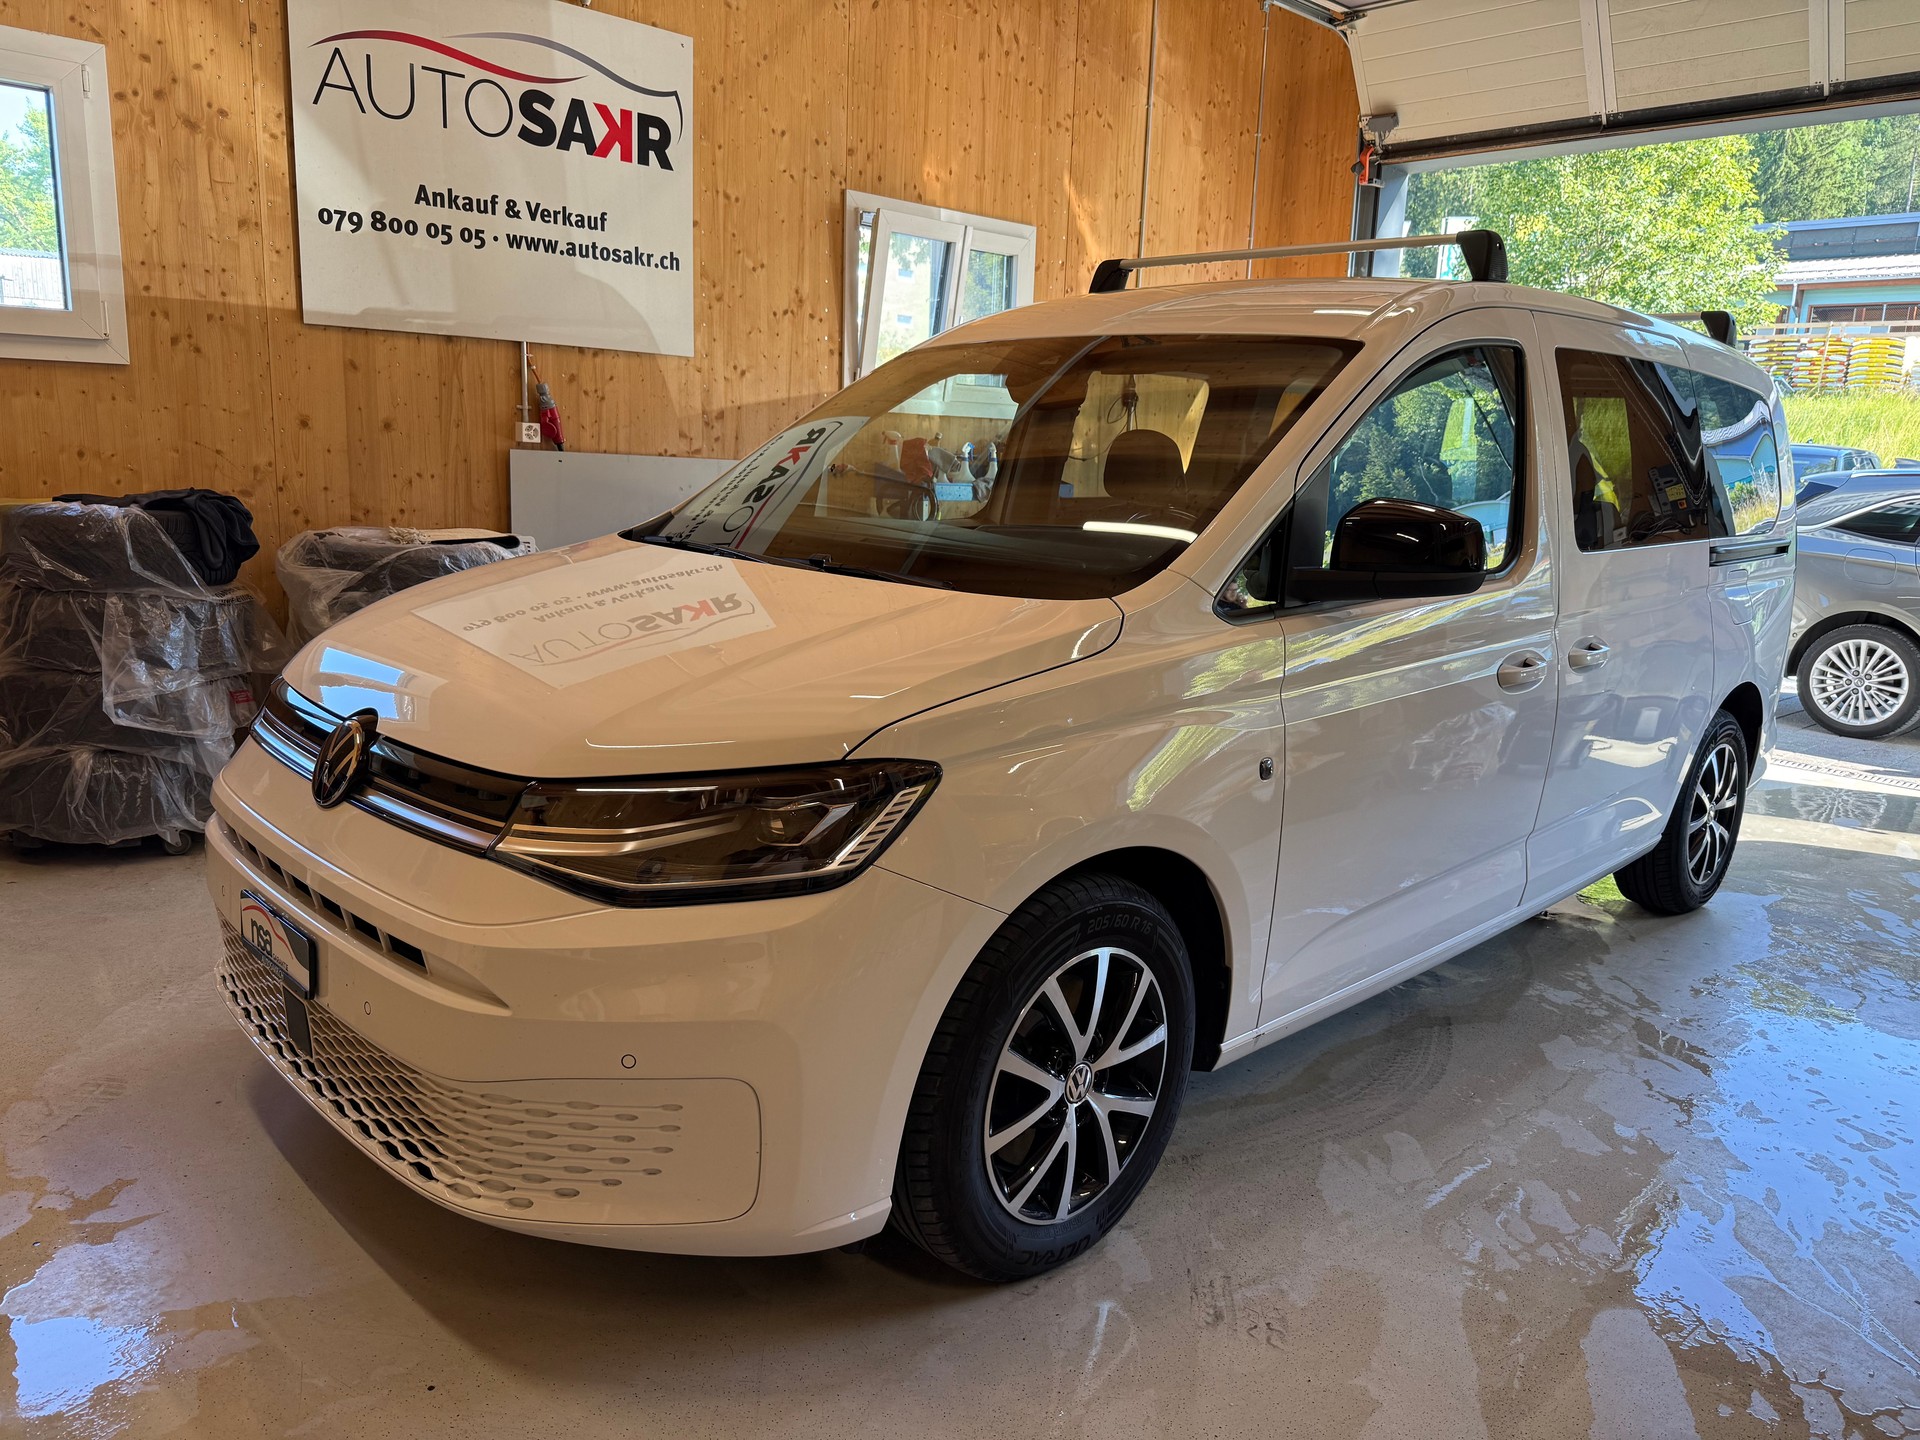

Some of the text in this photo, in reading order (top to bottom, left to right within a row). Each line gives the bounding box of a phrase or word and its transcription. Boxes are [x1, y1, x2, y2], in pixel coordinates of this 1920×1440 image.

[312, 47, 673, 171] AUTOSAKR
[415, 184, 607, 232] Ankauf & Verkauf
[318, 207, 363, 233] 079
[371, 210, 418, 236] 800
[426, 223, 452, 245] 05
[460, 227, 486, 249] 05
[506, 232, 680, 271] www.autosakr.ch
[1087, 914, 1130, 936] 205/60
